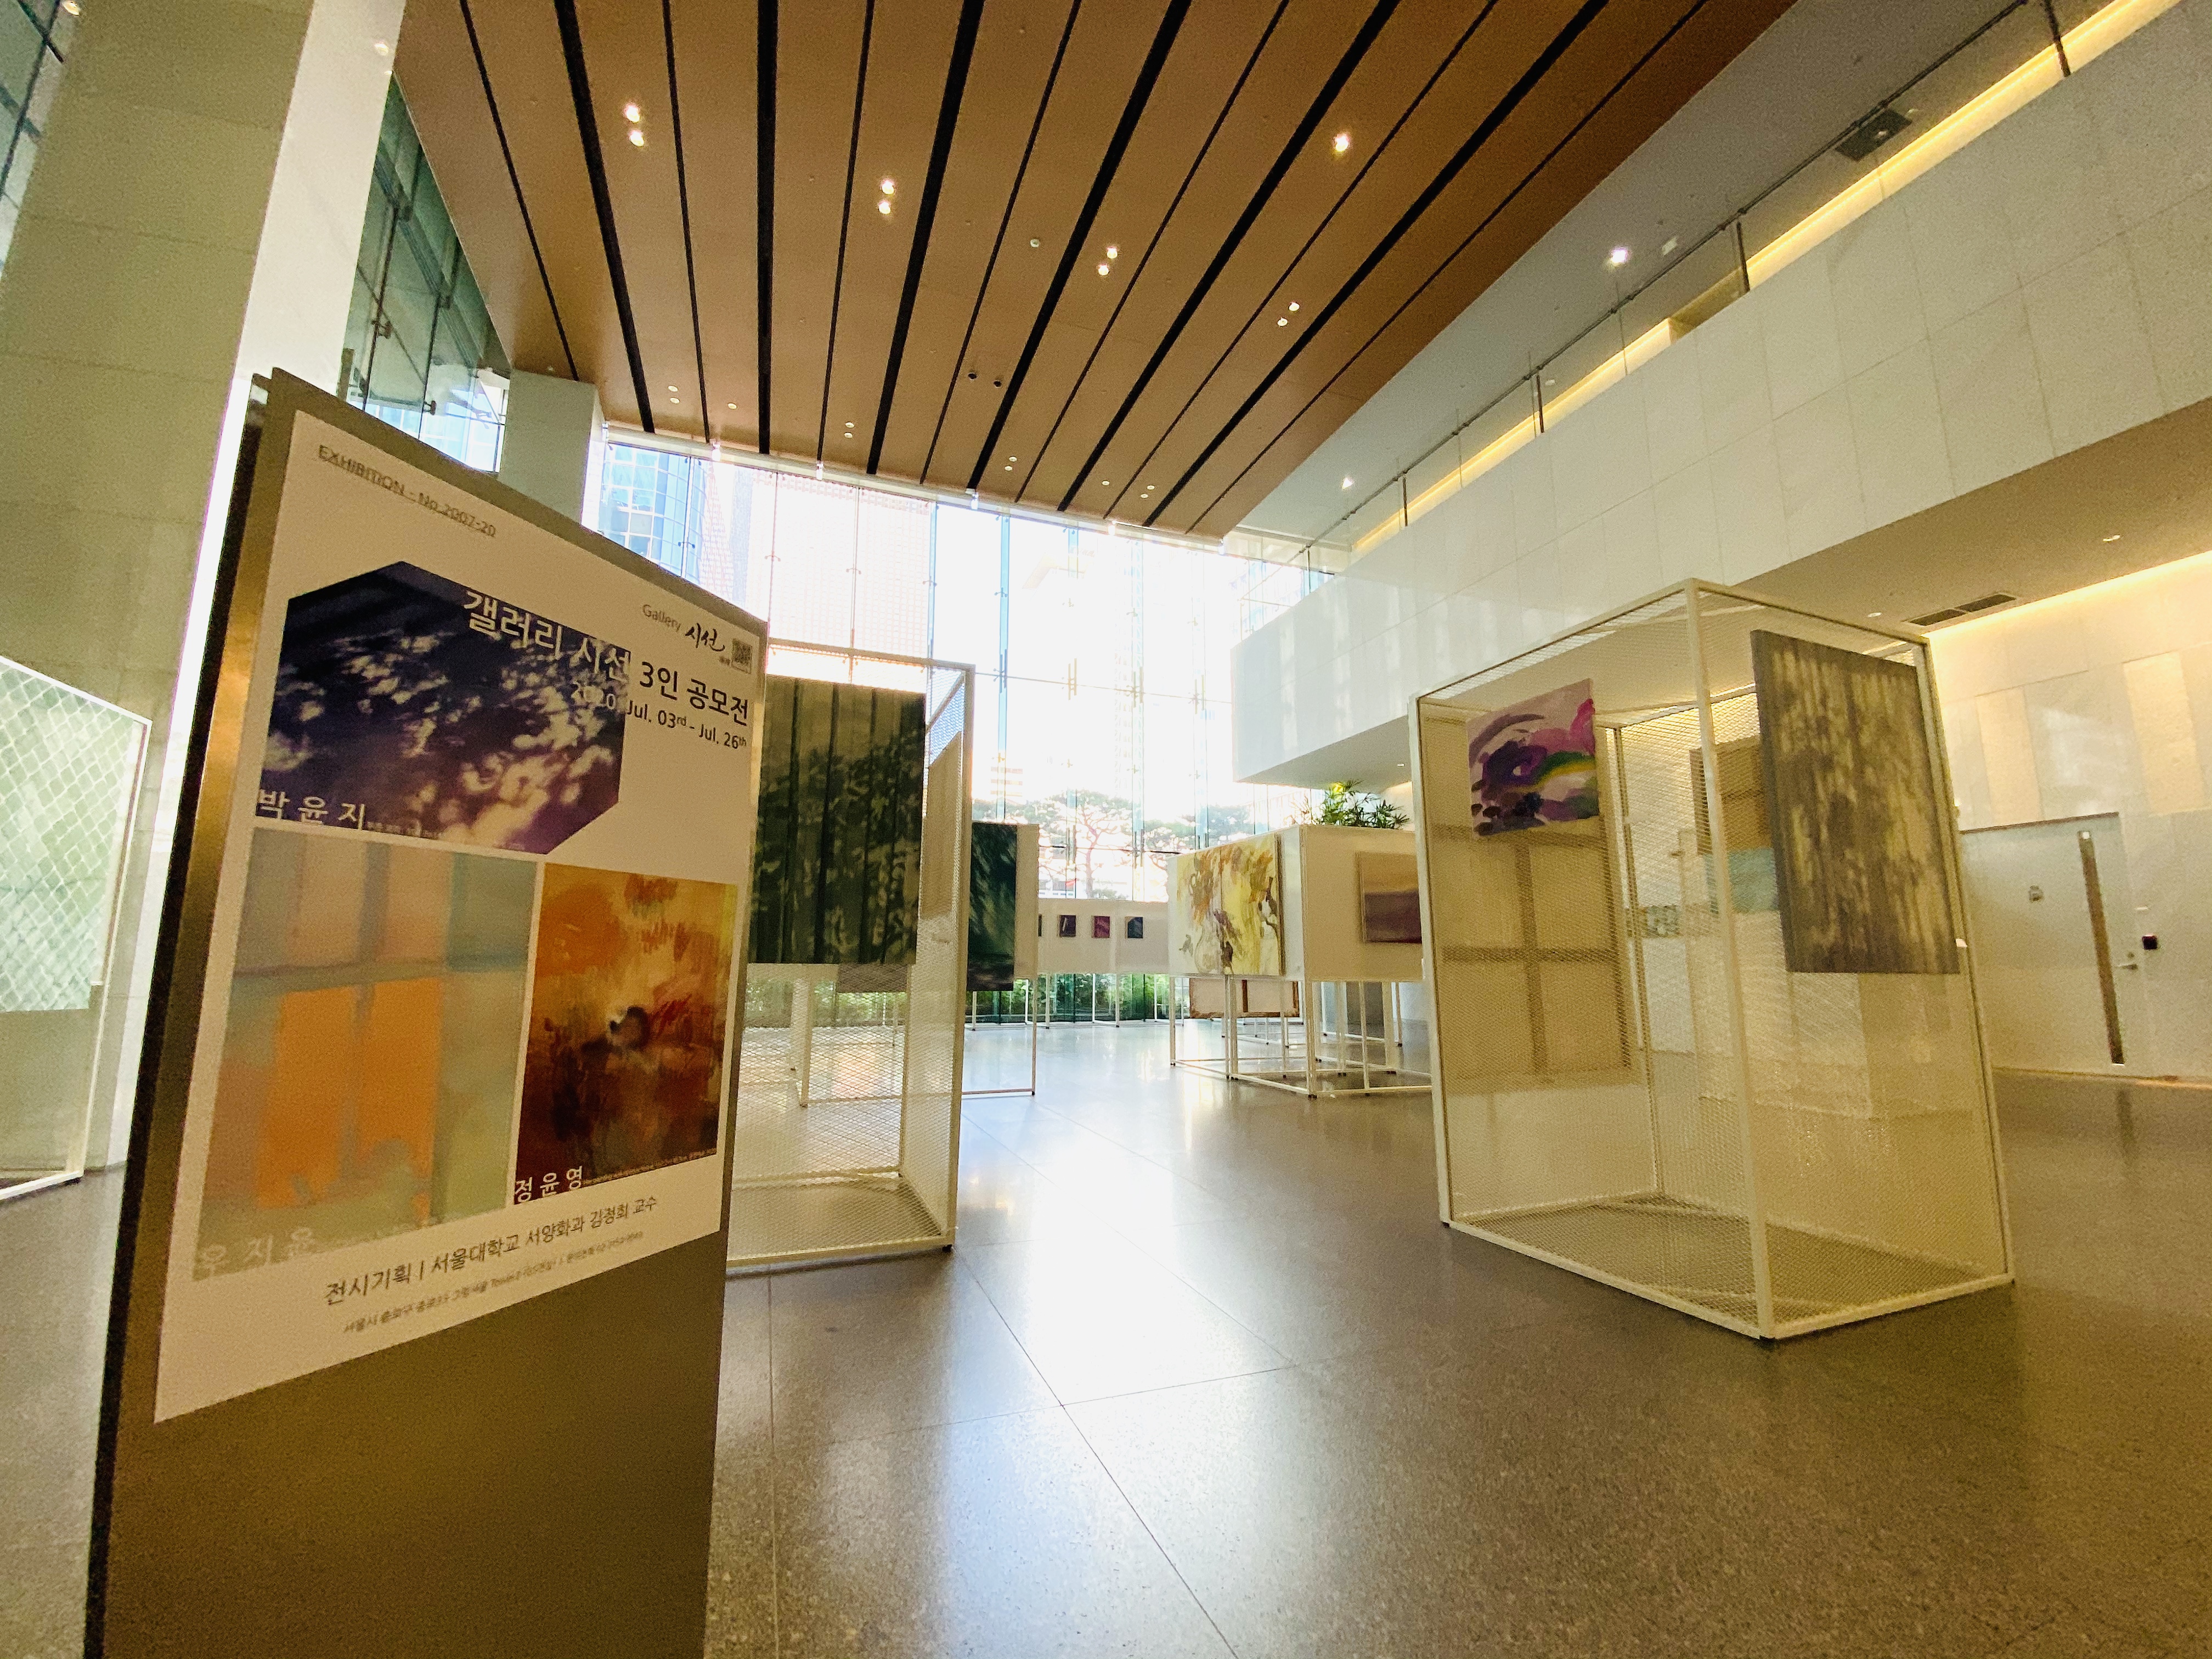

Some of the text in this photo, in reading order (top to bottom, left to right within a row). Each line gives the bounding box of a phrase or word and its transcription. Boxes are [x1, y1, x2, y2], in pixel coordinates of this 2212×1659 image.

[318, 445, 405, 495] EXHIBITION
[642, 604, 682, 632] Gallery
[464, 591, 748, 726] 갤러리 시선 3인 공모전
[626, 700, 652, 723] Jul.
[698, 724, 719, 744] Jul.
[324, 1263, 411, 1305] 전시기획
[432, 1234, 521, 1273] 서울대학교
[526, 1215, 585, 1245] 서양화과
[633, 1196, 657, 1214] 교수
